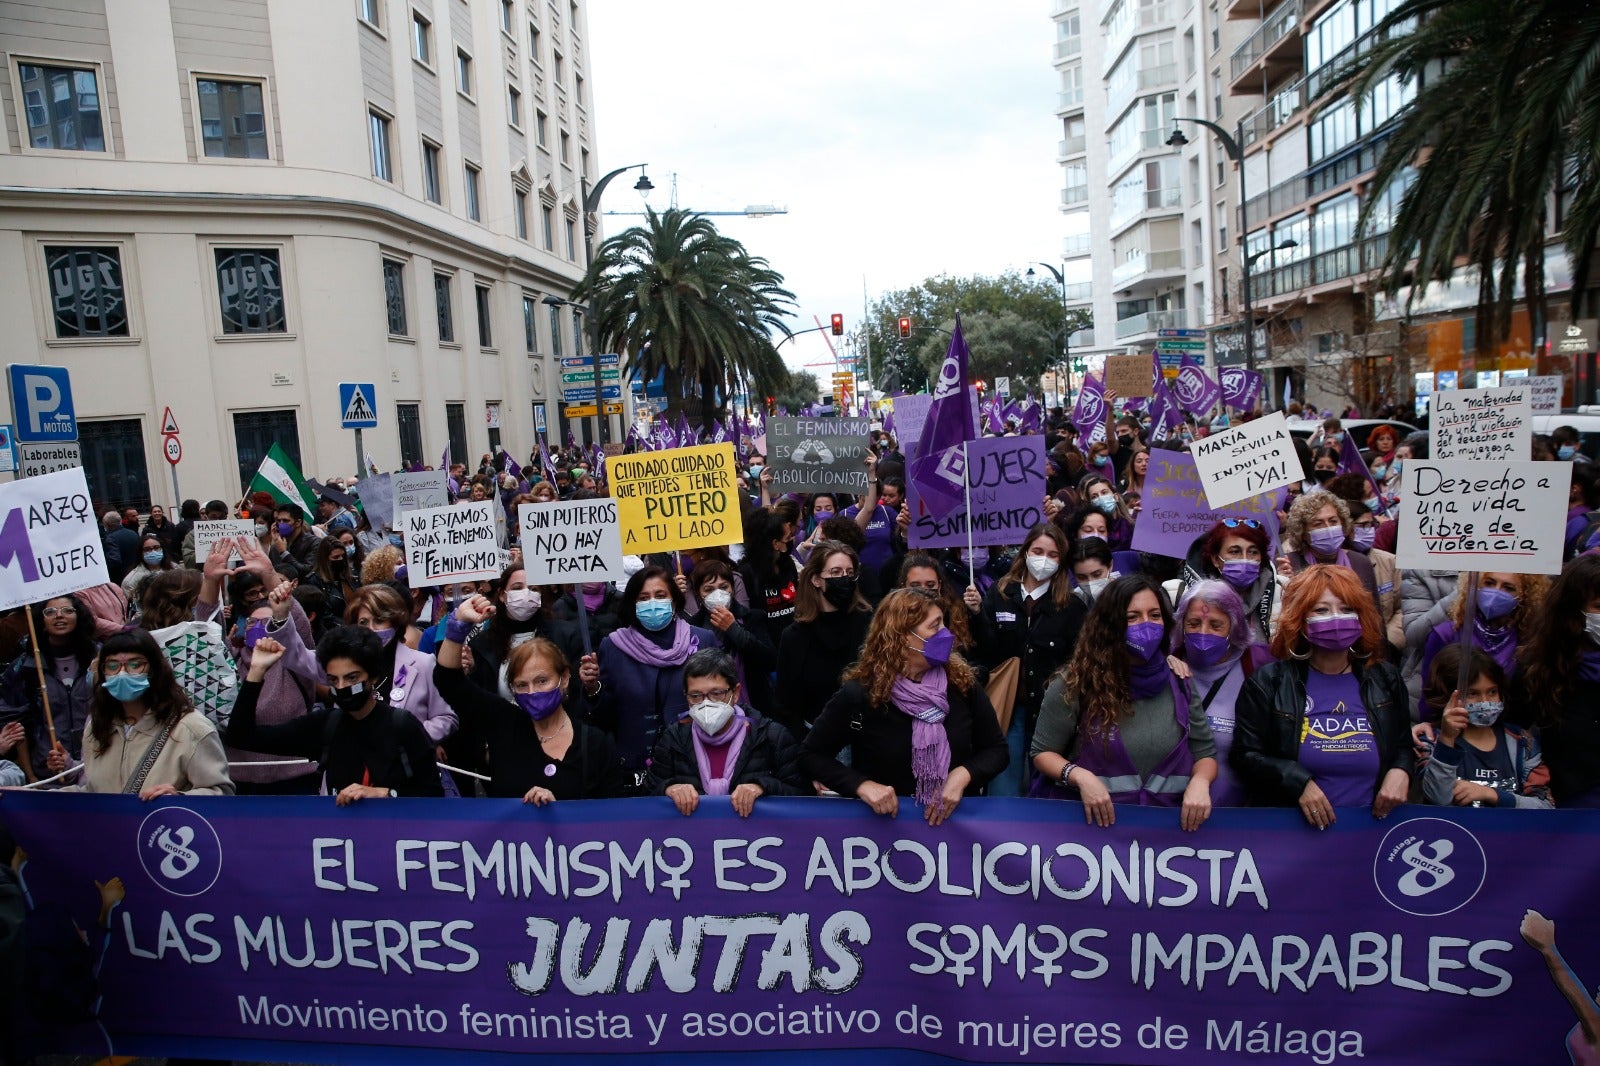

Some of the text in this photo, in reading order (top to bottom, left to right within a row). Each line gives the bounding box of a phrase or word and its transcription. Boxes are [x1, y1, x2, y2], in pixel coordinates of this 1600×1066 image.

[24, 374, 61, 433] P
[1436, 393, 1456, 412] La
[43, 421, 73, 433] MOTOS
[775, 420, 869, 436] EL FEMINISMO
[1437, 429, 1449, 437] es
[1455, 426, 1477, 436] una
[168, 444, 179, 454] 30
[1198, 429, 1247, 457] MARÍA
[1232, 430, 1286, 458] SEVILLA
[1437, 431, 1515, 448] del derecho de
[24, 448, 78, 461] Laborables
[775, 445, 861, 458] ES UNO
[1437, 448, 1455, 460] las
[1458, 444, 1502, 458] mujeres
[1504, 443, 1515, 452] a
[27, 465, 39, 477] de
[40, 465, 47, 476] 8
[1212, 450, 1280, 482] INDULTO
[616, 470, 731, 499] QUE PUEDES TENER
[773, 466, 869, 489] ABOLICIONISTA
[1414, 467, 1550, 496] Derecho a
[645, 490, 728, 520] PUTERO
[1152, 507, 1180, 520] FUERA
[1417, 491, 1526, 515] una vida
[432, 508, 489, 530] ESTAMOS
[526, 503, 617, 530] SIN PUTEROS
[1419, 515, 1515, 537] libre de
[447, 524, 494, 546] TENEMOS
[536, 529, 603, 554] NO HAY
[626, 518, 725, 544] A TU LADO
[1426, 534, 1539, 552] violencia
[545, 554, 609, 576] TRATA
[768, 610, 780, 618] LOS
[165, 843, 192, 859] marzo
[1387, 836, 1417, 863] Málaga
[313, 836, 1268, 910] EL FEMINISMO ES ABOLICIONISTA
[1410, 856, 1445, 875] marzo
[122, 910, 1514, 998] LAS MUJERES JUNTAS SOMOS IMPARABLES
[238, 996, 1365, 1065] Movimiento feminista y asociativo de mujeres de Málaga
